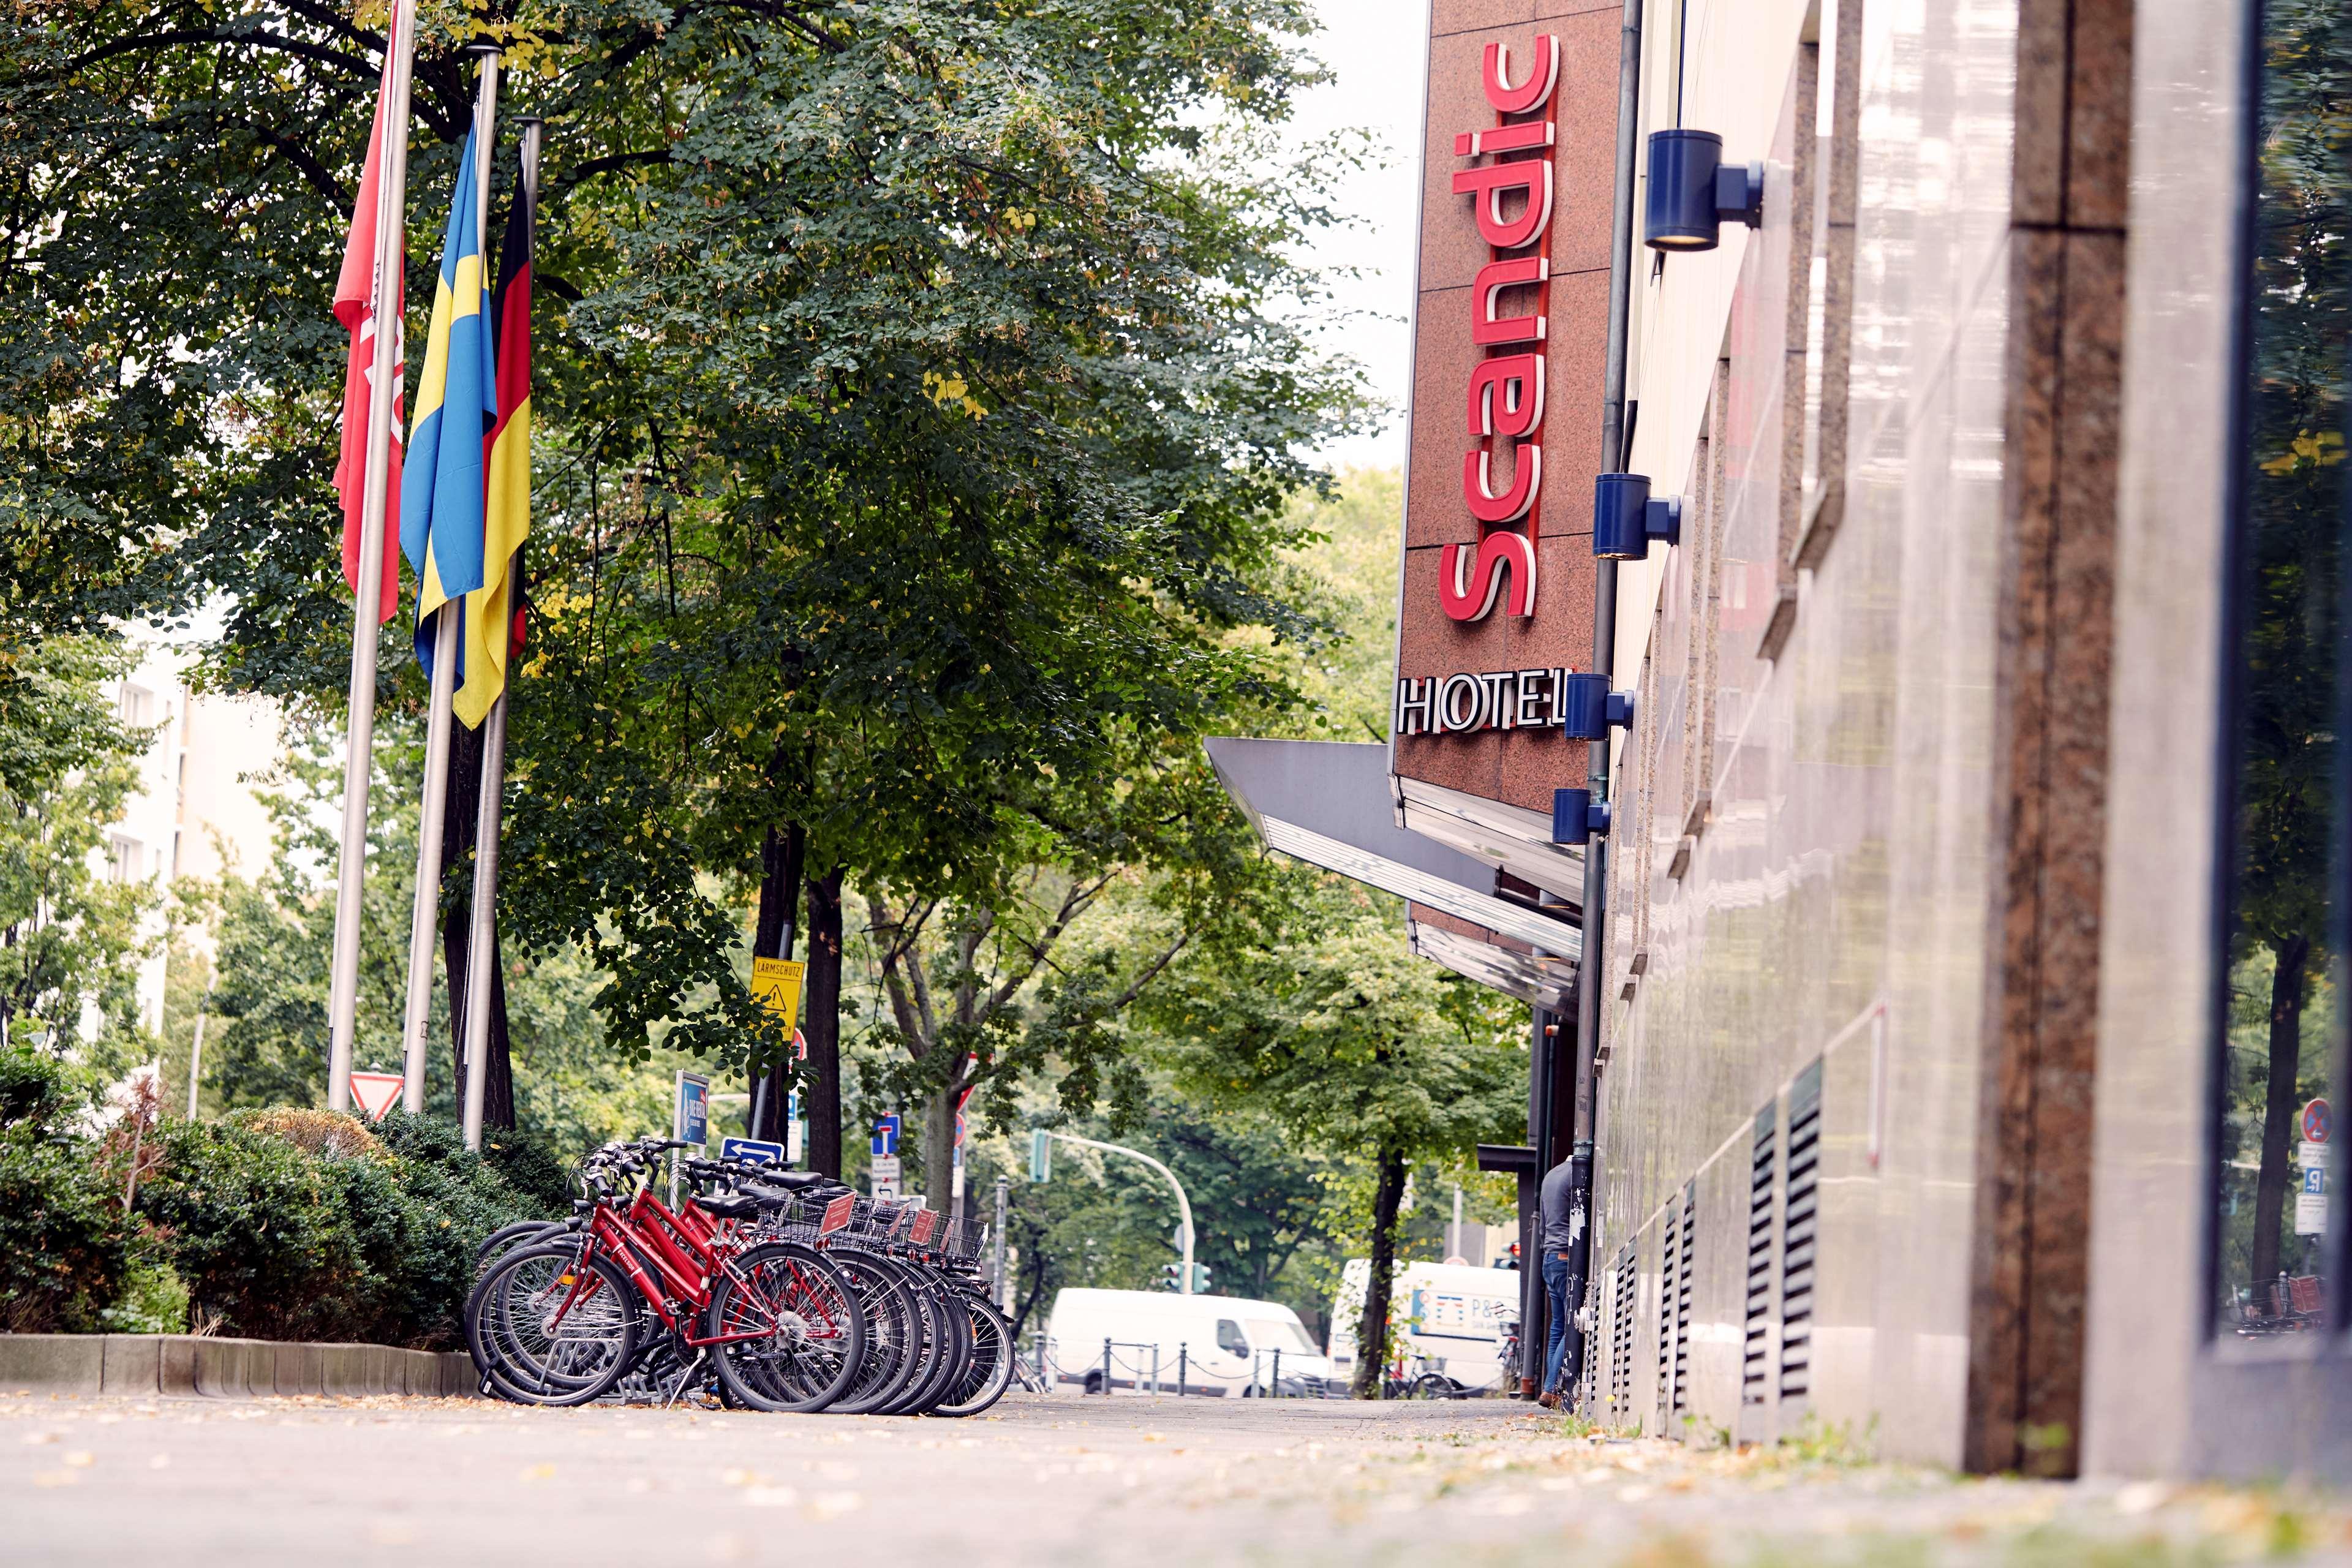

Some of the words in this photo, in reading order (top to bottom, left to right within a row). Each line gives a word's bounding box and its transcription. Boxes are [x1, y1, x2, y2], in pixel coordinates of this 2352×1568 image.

[1441, 34, 1560, 624] scandic
[1396, 668, 1568, 736] HOTEL
[617, 1250, 635, 1271] EXCELSIOR
